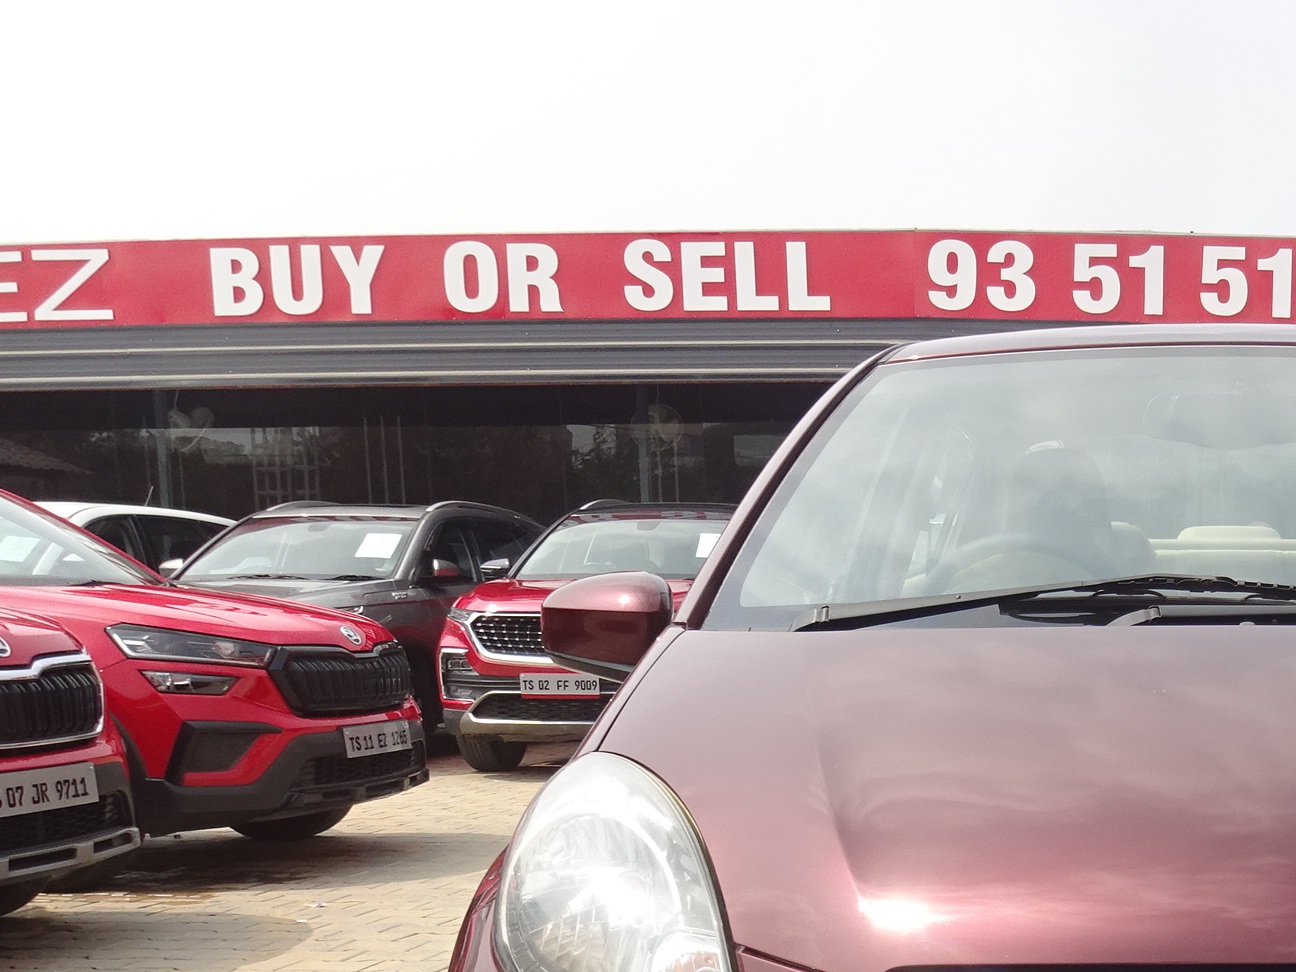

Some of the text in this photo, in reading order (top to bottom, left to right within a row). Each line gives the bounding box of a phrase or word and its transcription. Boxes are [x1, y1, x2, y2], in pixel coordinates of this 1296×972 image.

[209, 244, 385, 317] BUY
[443, 240, 564, 313] OR
[623, 238, 832, 312] SELL
[927, 238, 1036, 312] 93
[1072, 243, 1165, 316] 51
[1199, 245, 1293, 319] 51
[522, 680, 598, 691] TS 02 FF 9009
[6, 777, 90, 809] 07 JR 9711
